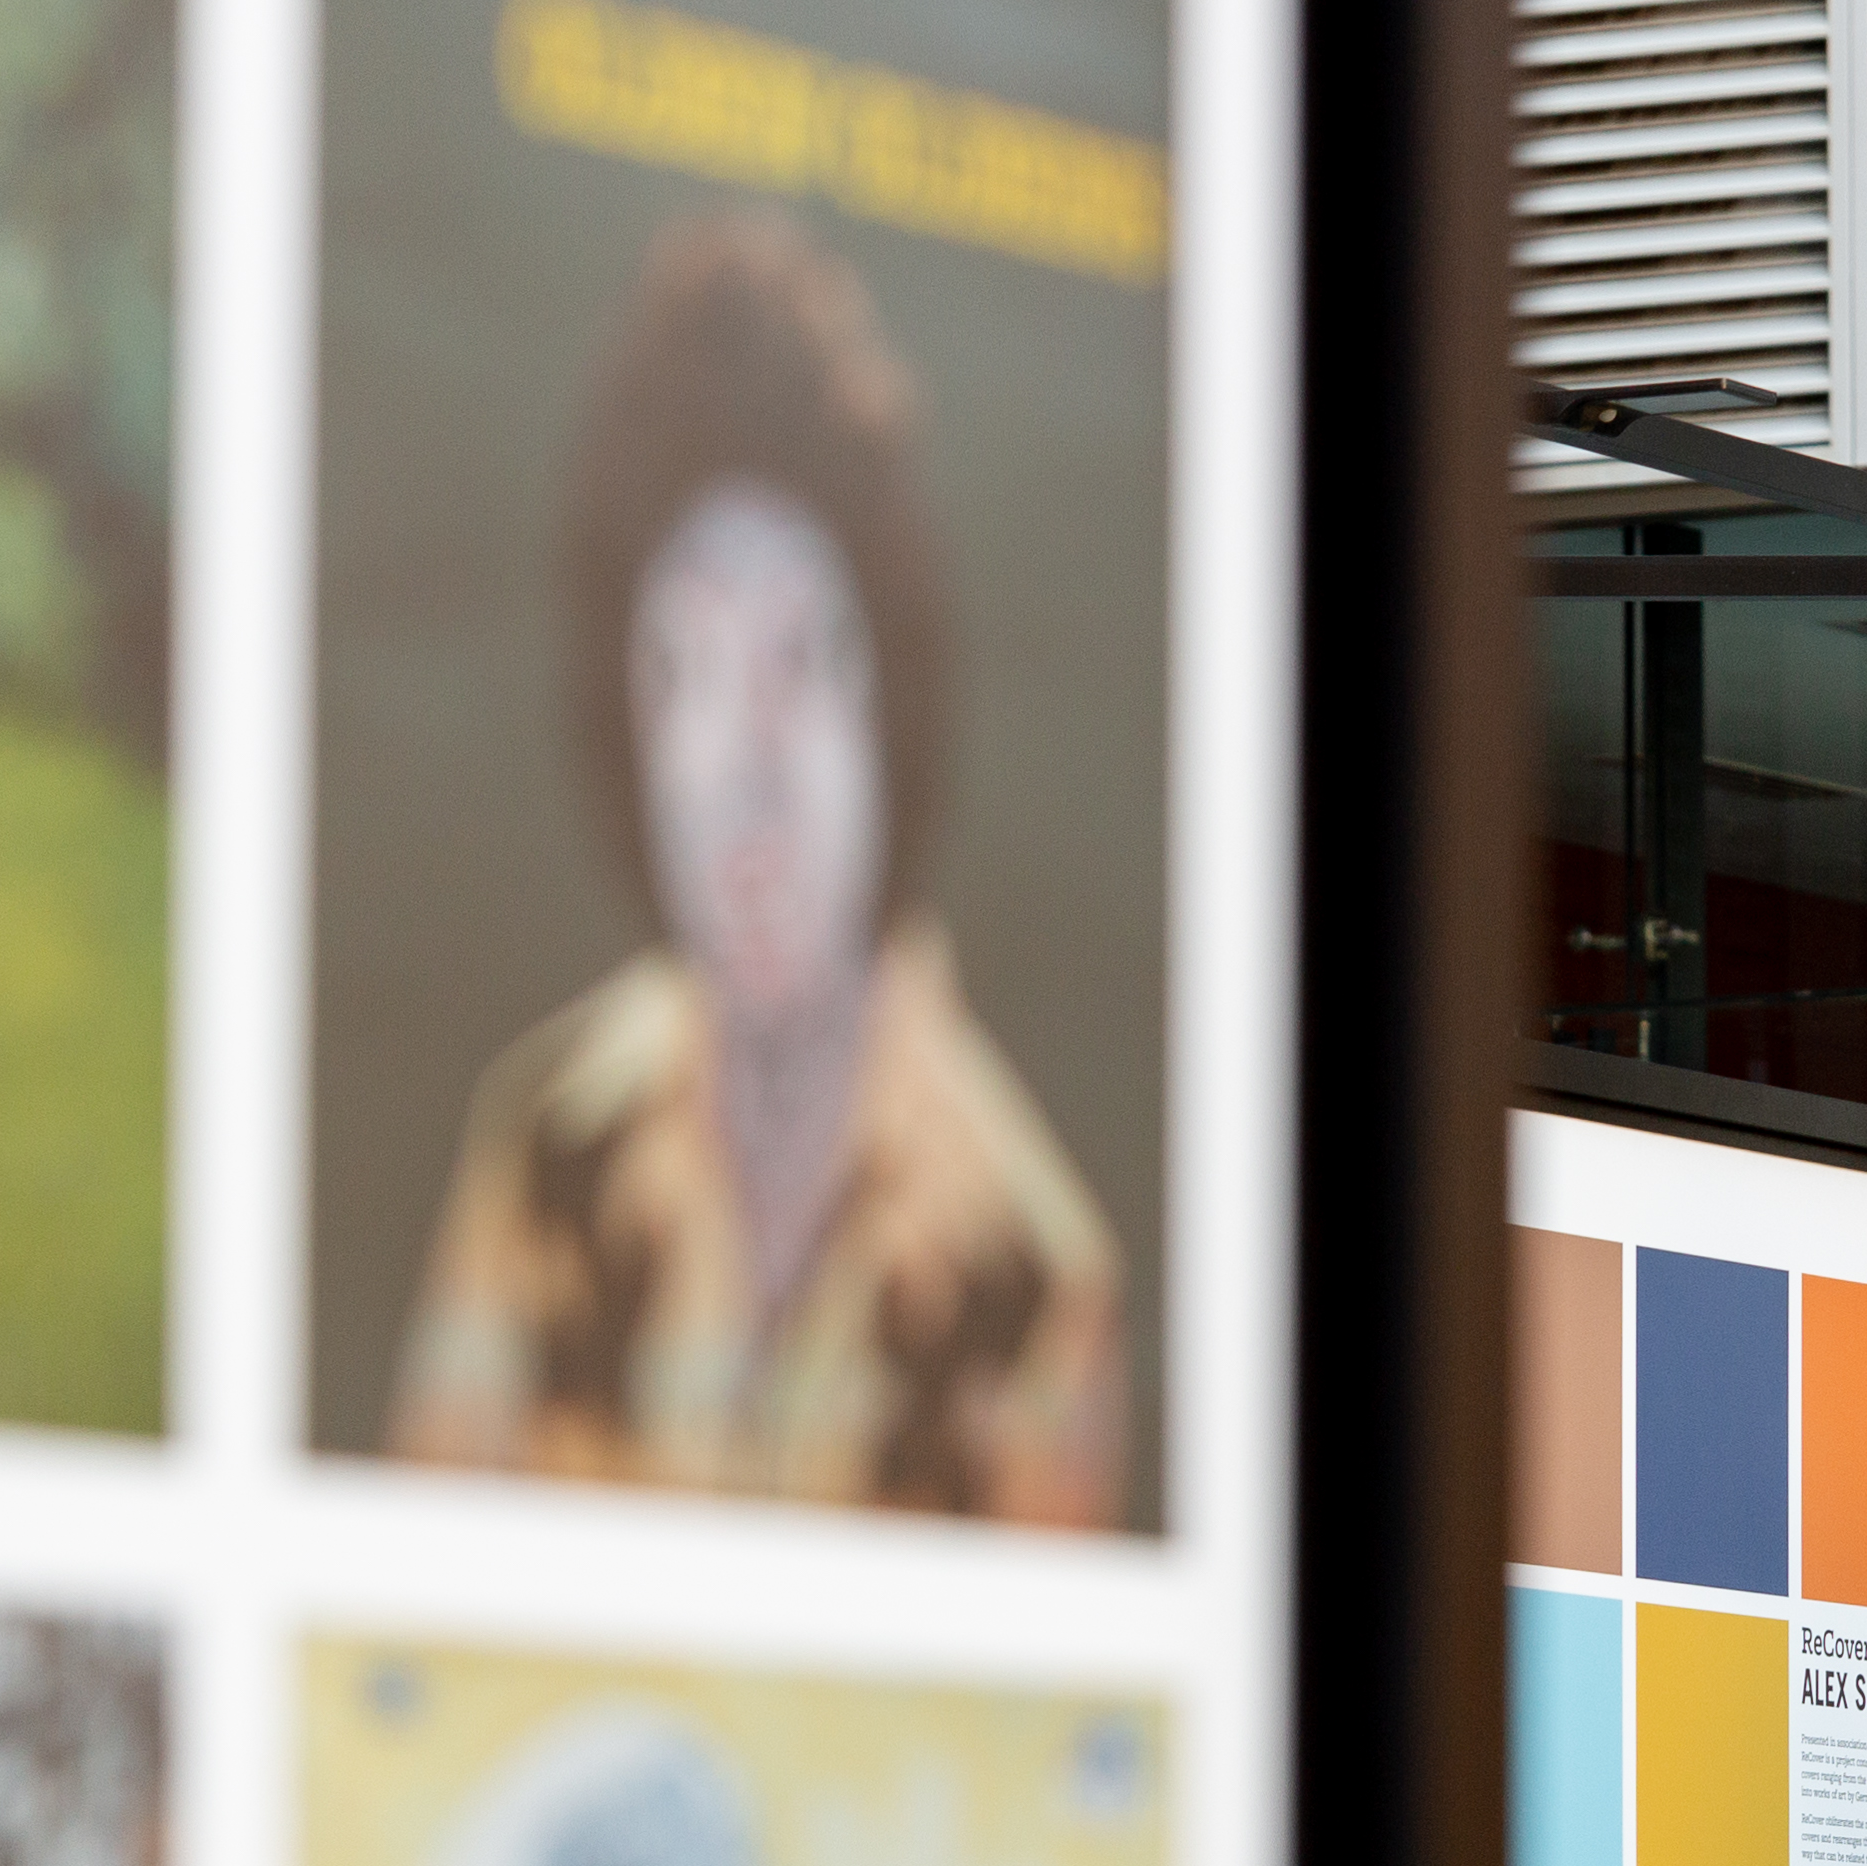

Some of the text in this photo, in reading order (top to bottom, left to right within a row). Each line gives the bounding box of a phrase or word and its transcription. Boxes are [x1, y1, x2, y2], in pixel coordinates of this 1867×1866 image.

[1802, 1668, 1848, 1709] ALEX
[1801, 1734, 1829, 1747] Presented
[1837, 1739, 1867, 1751] association
[1801, 1751, 1824, 1764] ReCover
[1836, 1756, 1855, 1770] project
[1801, 1771, 1820, 1781] covers
[1821, 1773, 1842, 1786] ranging
[1813, 1789, 1830, 1800] works
[1801, 1813, 1825, 1826] ReCover
[1825, 1816, 1854, 1829] obliterates
[1801, 1833, 1820, 1843] covers
[1832, 1836, 1862, 1849] rearranges
[1845, 1853, 1865, 1865] related
